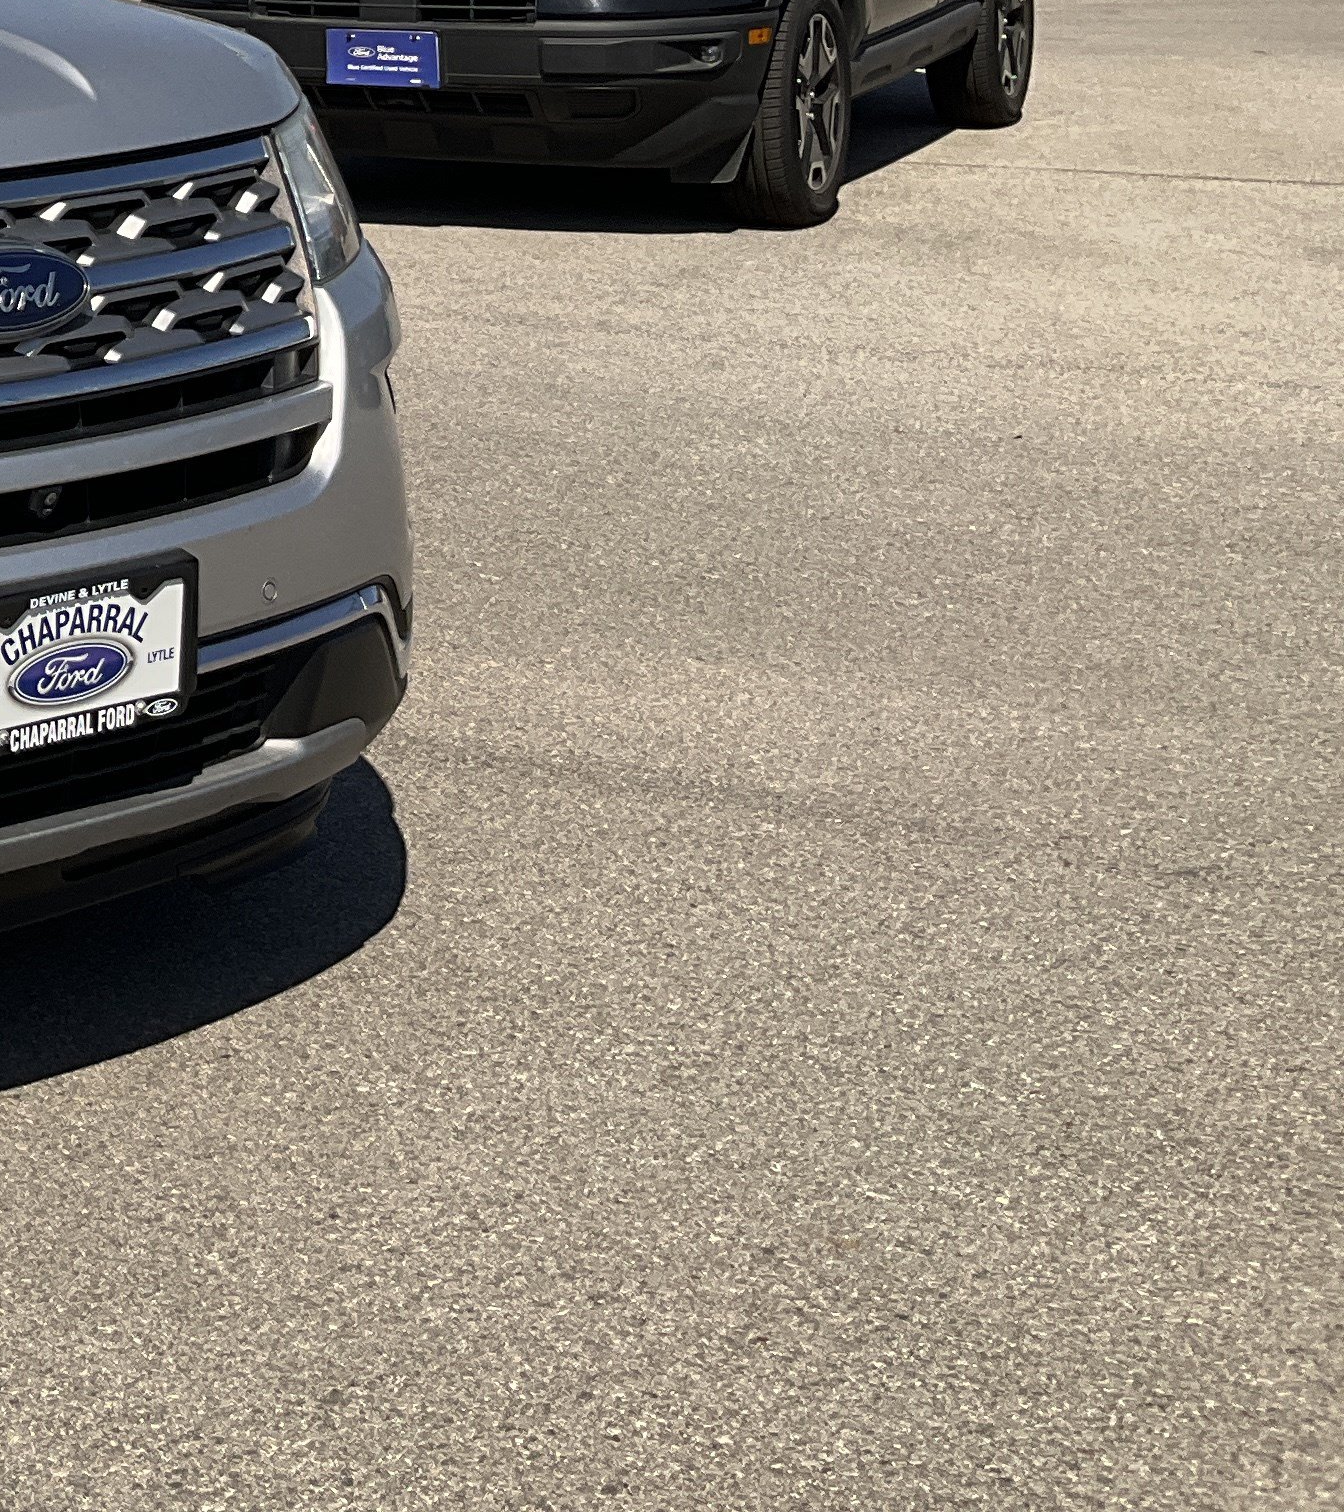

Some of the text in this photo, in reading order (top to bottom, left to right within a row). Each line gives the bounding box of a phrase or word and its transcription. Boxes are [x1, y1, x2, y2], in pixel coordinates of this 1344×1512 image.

[377, 45, 395, 54] Blue
[377, 53, 419, 63] Advantage
[30, 579, 129, 610] DEVINE & LYTLE
[0, 603, 150, 666] CHAPARRAL
[147, 647, 175, 664] LYTLE
[36, 652, 106, 694] Ford
[152, 700, 172, 714] Ford
[10, 703, 135, 753] CHAPARRAL FORD
